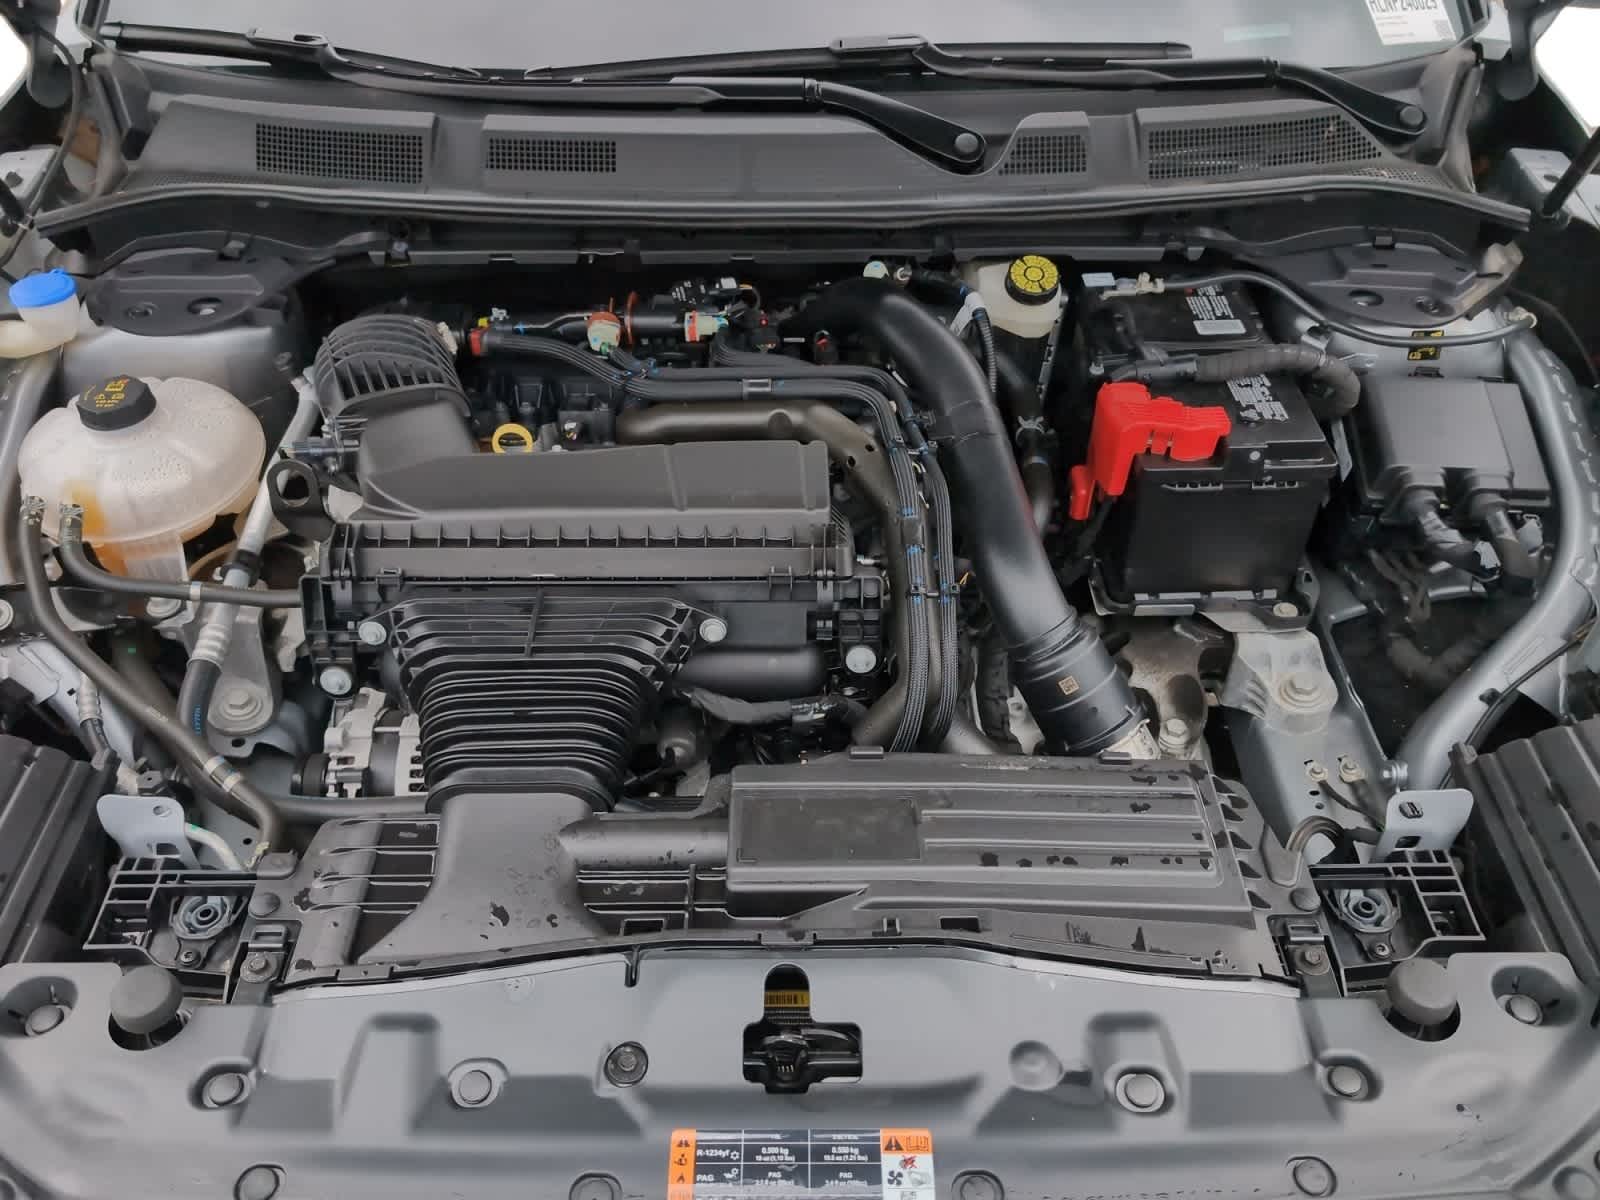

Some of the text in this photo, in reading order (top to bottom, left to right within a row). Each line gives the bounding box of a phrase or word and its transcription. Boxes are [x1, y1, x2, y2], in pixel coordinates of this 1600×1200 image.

[696, 1149, 730, 1158] R-1234yf
[780, 1147, 789, 1156] kg
[850, 1146, 859, 1155] kg
[696, 1174, 715, 1182] PAG
